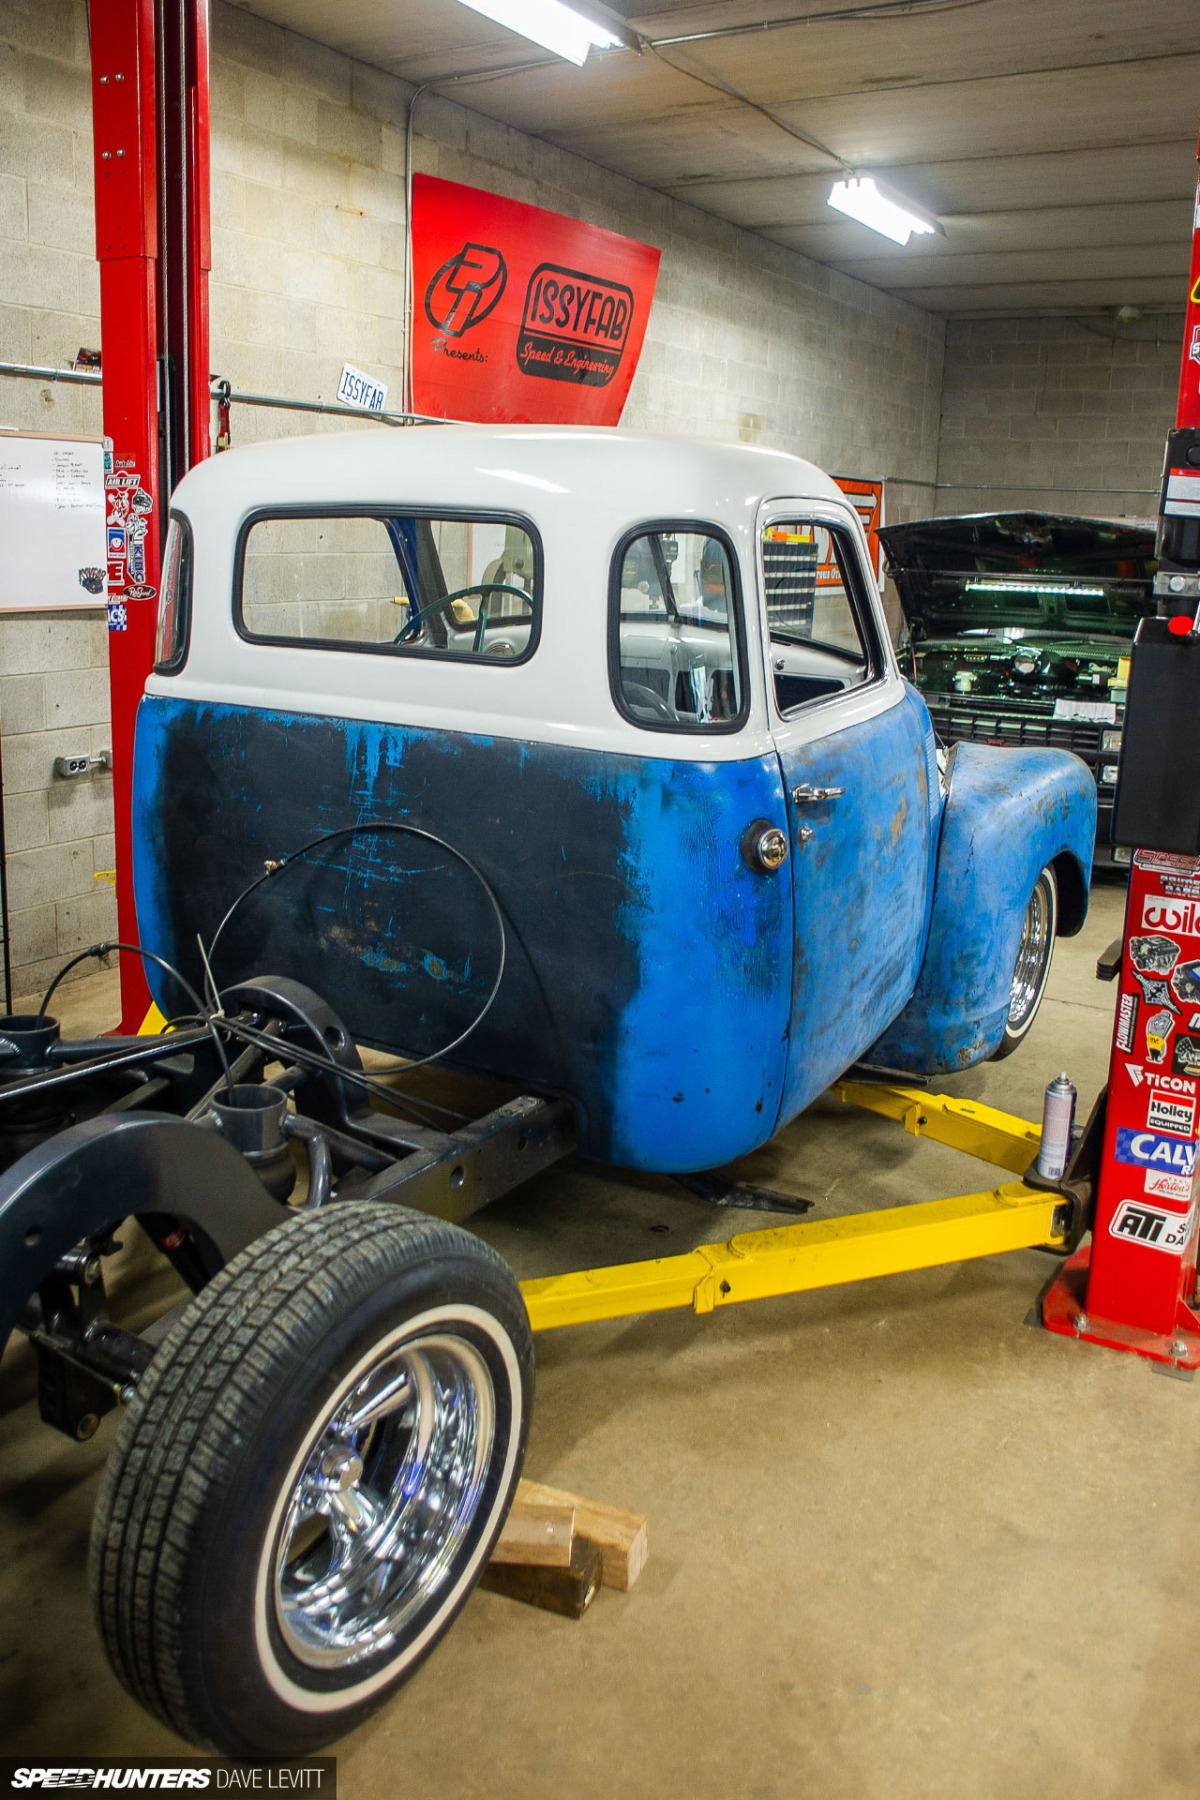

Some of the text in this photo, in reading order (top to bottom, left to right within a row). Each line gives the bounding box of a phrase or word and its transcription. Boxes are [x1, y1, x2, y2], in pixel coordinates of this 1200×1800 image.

[530, 277, 628, 341] ISSYFAB
[431, 337, 488, 362] Presents:
[520, 341, 615, 380] Speed & Engineering
[1116, 993, 1133, 1053] FLOWMASTER
[1150, 1118, 1190, 1131] EQUIPPED
[1151, 1101, 1193, 1123] Holley
